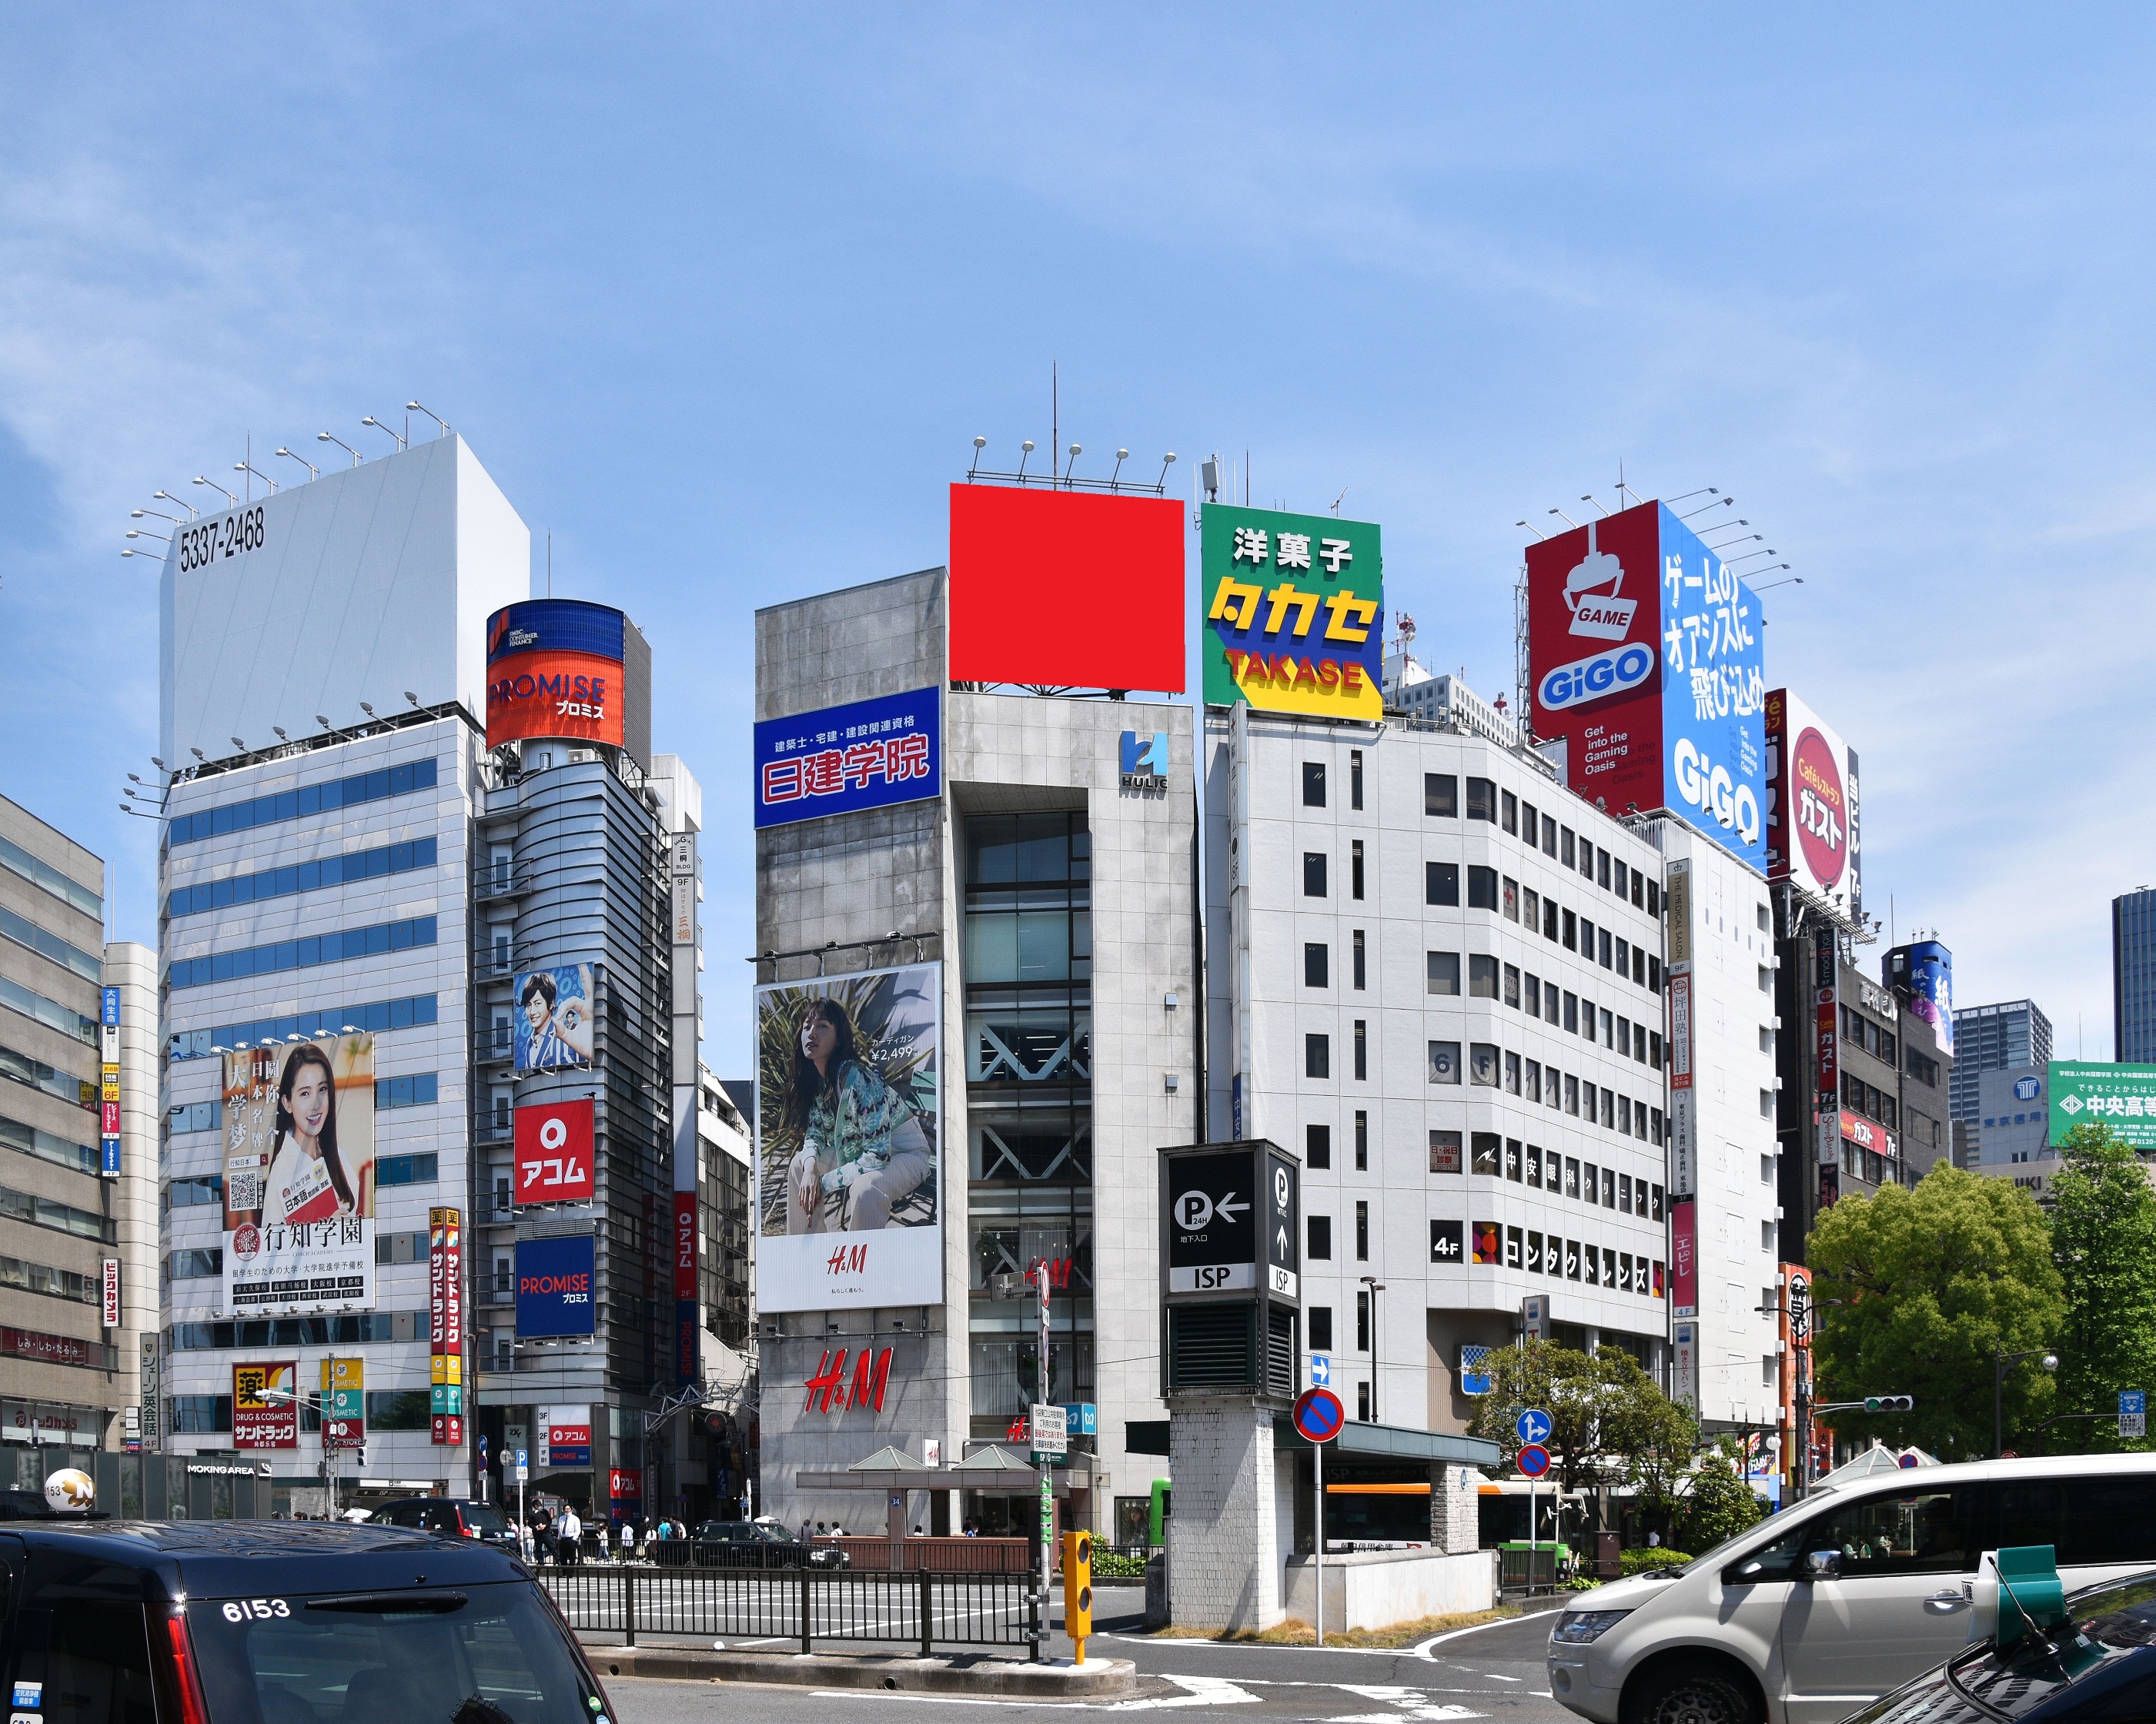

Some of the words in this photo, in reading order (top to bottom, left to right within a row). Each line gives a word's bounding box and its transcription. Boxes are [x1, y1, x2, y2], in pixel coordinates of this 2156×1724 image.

[180, 506, 265, 573] 5337-2468
[1234, 527, 1352, 573] 洋菓子
[1664, 553, 1739, 609] ゲームの
[1208, 576, 1379, 643] タカセ
[1578, 608, 1630, 626] GAME
[510, 633, 538, 642] CONSUMER
[1664, 605, 1754, 673] オアシスに
[1225, 648, 1362, 689] TAKASE
[490, 674, 606, 708] PROMISE
[557, 700, 604, 719] プロミス
[775, 716, 914, 753] 建築士・宅建・建設関連資格
[1585, 725, 1603, 738] Get
[1588, 738, 1609, 750] into
[1610, 732, 1628, 744] the
[1585, 743, 1628, 763] Gaming
[1741, 738, 1750, 750] into
[763, 733, 930, 805] 日建学院
[1585, 760, 1616, 775] Oasis
[1740, 751, 1757, 770] Gaming
[1740, 760, 1753, 777] Oasis
[1121, 776, 1168, 789] HULIC
[1800, 787, 1842, 851] ガスト
[1849, 773, 1860, 854] 当ビル
[680, 846, 687, 862] 三桐
[677, 916, 690, 941] 三桐
[106, 989, 116, 1022] 大同生命
[1674, 996, 1687, 1035] 坪田塾
[872, 1035, 914, 1046] カーディガン
[871, 1047, 913, 1061] ¥2,499
[1820, 1032, 1833, 1074] ガスト
[105, 1091, 118, 1099] 6F
[252, 1062, 263, 1148] 日本名牌
[266, 1060, 279, 1145] 圆你一个
[1821, 1093, 1835, 1104] 7F
[229, 1065, 246, 1151] 大学梦
[1854, 1121, 1874, 1146] ガスト
[1887, 1135, 1896, 1157] 7F
[522, 1158, 586, 1188] アコム
[1507, 1151, 1658, 1209] 中安眼科クリニック
[1278, 1172, 1286, 1200] P
[285, 1189, 308, 1212] 日本語
[1185, 1197, 1205, 1225] P
[431, 1211, 443, 1225] 薬
[447, 1211, 458, 1225] 薬
[1277, 1208, 1287, 1218] 地下入口
[264, 1214, 363, 1251] 行知学園
[1181, 1235, 1207, 1243] 地下入口
[679, 1228, 692, 1267] アコム
[1435, 1238, 1459, 1255] 4F
[1677, 1239, 1690, 1277] エピレ
[232, 1261, 364, 1278] 留学生のための大学・大学院進学予備校
[827, 1244, 867, 1275] H&M
[1507, 1240, 1646, 1289] コンタクトレンズ
[313, 1280, 333, 1288] 大阪校
[341, 1278, 361, 1286] 京都校
[520, 1274, 589, 1295] PROMISE
[1195, 1267, 1230, 1288] ISP
[1276, 1268, 1288, 1291] ISP
[106, 1263, 115, 1322] ビックカメラ
[432, 1253, 443, 1342] サンドラッグ
[448, 1254, 459, 1343] サンドラッグ
[563, 1293, 588, 1305] プロミス
[18, 1337, 79, 1355] しみ・しわ・たるみ
[680, 1321, 692, 1376] PROMISE
[338, 1366, 346, 1375] 3F
[804, 1347, 894, 1415] H&M
[142, 1357, 156, 1436] シェーン英会話
[239, 1372, 263, 1405] 薬
[235, 1425, 294, 1440] サンドラッグ
[565, 1432, 587, 1441] アコム
[187, 1465, 228, 1474] MOKING
[227, 1466, 255, 1475] AREA
[519, 1452, 526, 1465] P
[620, 1478, 634, 1491] アコム
[1325, 1468, 1351, 1481] ISP
[76, 1481, 93, 1498] N
[222, 1599, 292, 1622] 6153
[15, 1689, 39, 1698] 空気清浄機
